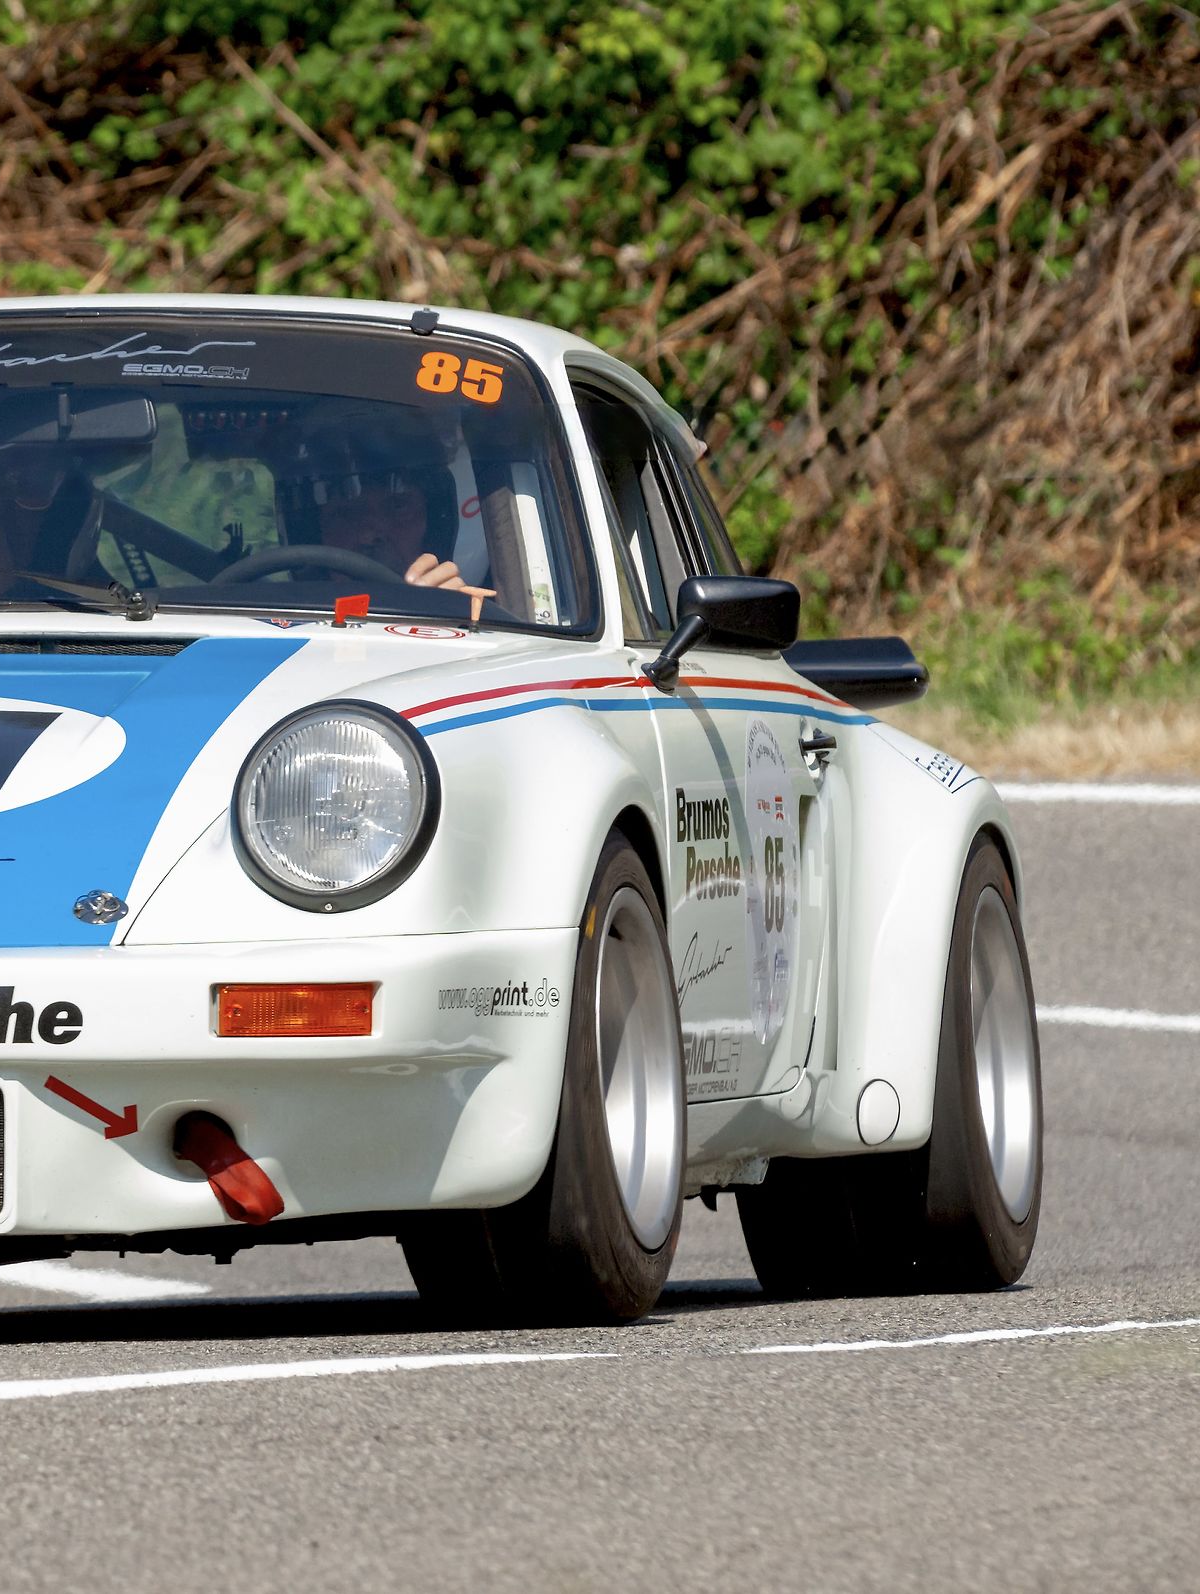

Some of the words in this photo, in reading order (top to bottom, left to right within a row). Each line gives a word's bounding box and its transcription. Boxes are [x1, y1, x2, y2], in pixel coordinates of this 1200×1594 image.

[416, 351, 504, 403] 85
[676, 788, 730, 843] Brumos
[686, 841, 740, 901] Porsche
[765, 836, 785, 933] 85
